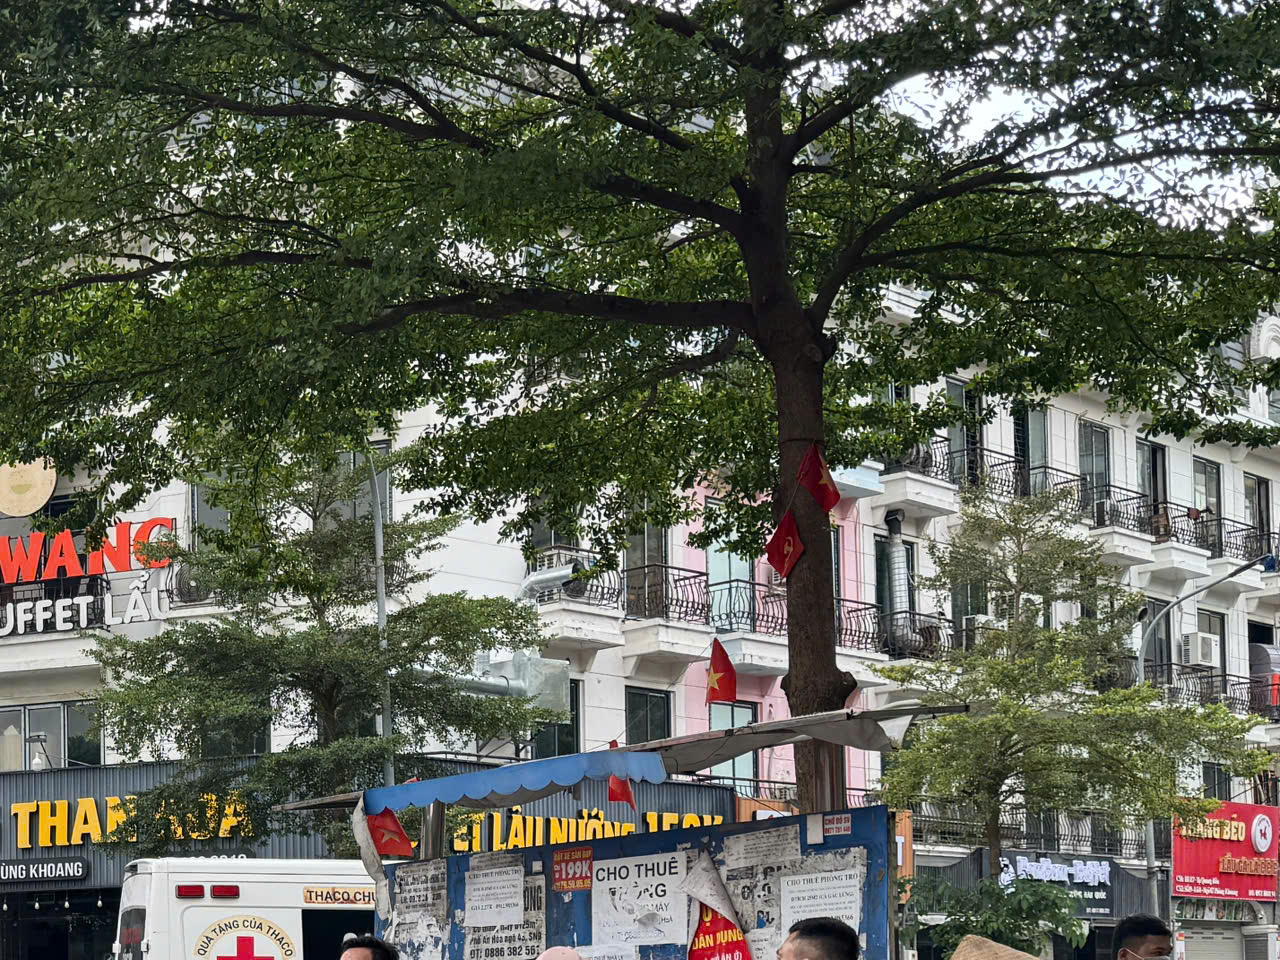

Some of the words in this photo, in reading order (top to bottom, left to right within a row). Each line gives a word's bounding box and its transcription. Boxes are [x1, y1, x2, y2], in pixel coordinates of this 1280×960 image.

[104, 571, 171, 626] LẨU
[29, 861, 83, 879] KHOANG
[560, 860, 591, 879] 199K
[596, 865, 630, 881] CHO
[634, 857, 679, 878] THUÊ
[307, 890, 350, 902] THACO
[197, 933, 215, 956] QUÀ
[211, 919, 240, 937] TẶNG
[242, 917, 264, 931] CỦA
[265, 925, 294, 957] THACO
[507, 945, 523, 956] 382
